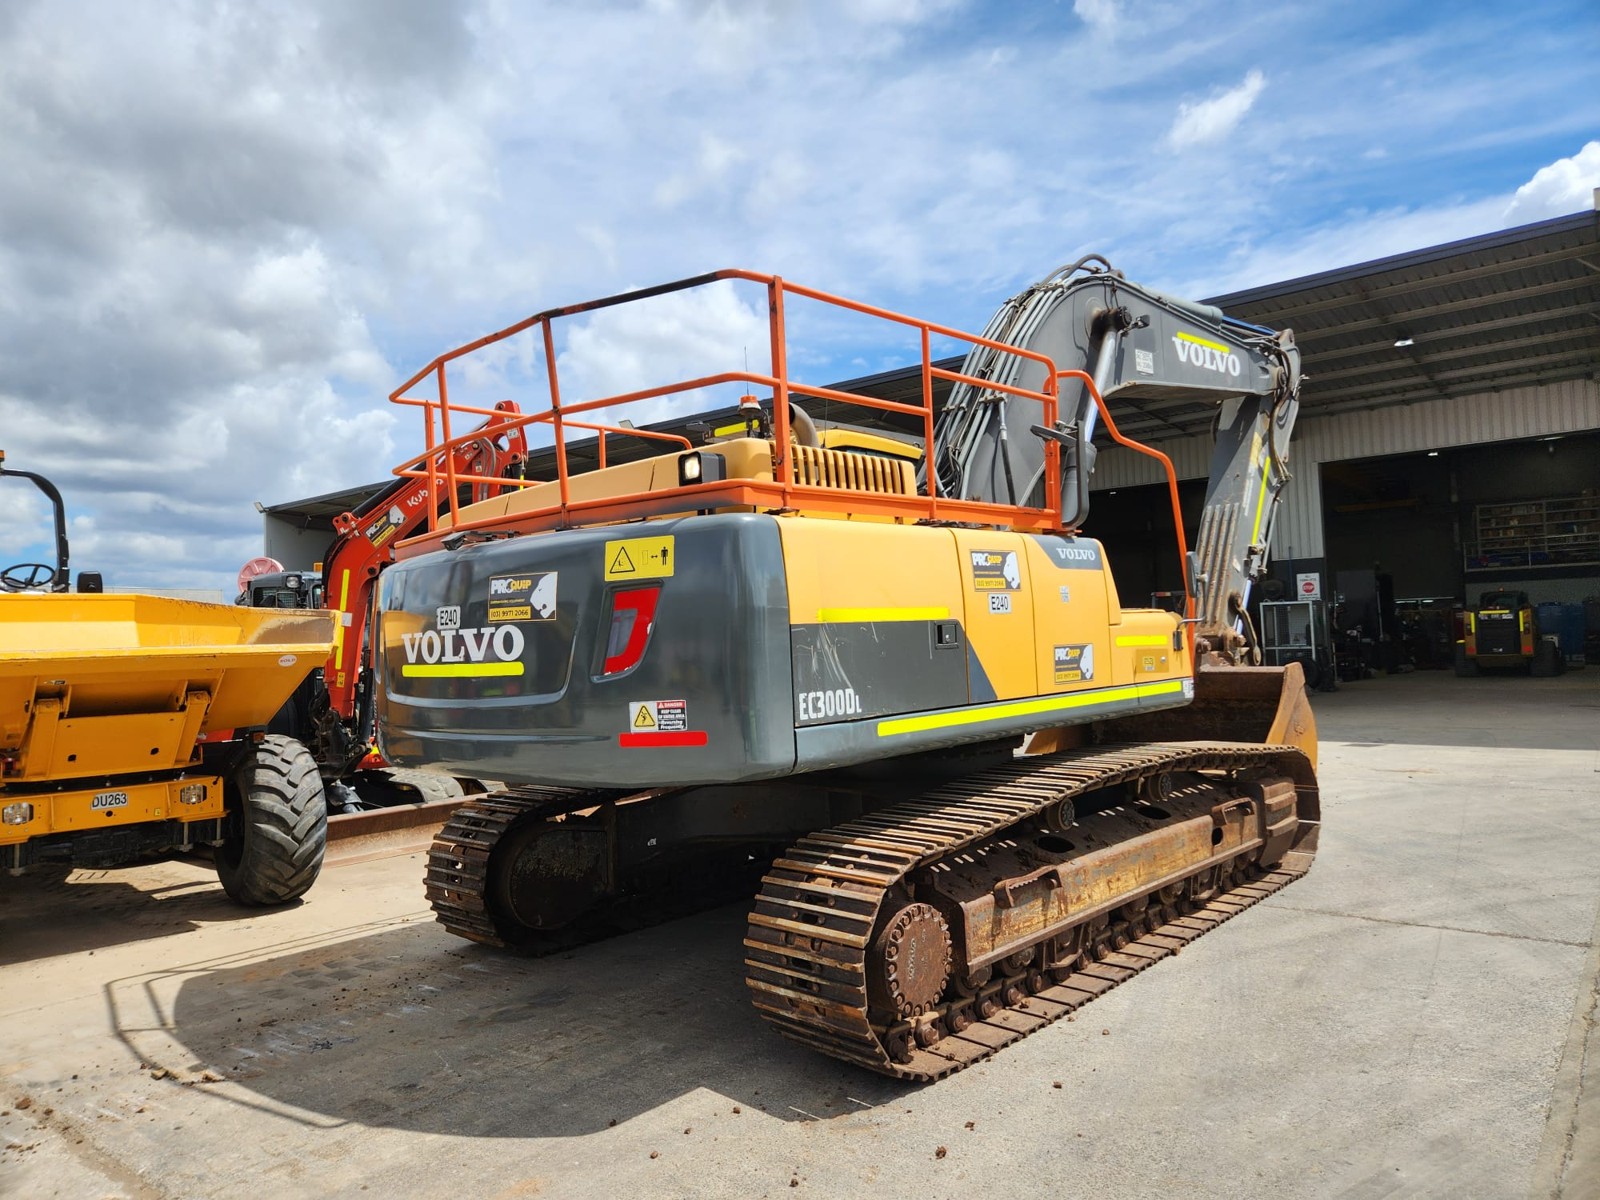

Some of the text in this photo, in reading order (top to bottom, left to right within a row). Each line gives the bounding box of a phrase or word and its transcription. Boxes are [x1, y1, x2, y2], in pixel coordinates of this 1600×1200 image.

[1171, 336, 1241, 377] VOLVO
[407, 478, 444, 507] Kuba
[1056, 547, 1096, 561] VOLVO
[491, 578, 532, 595] PROQUIP
[991, 596, 1009, 611] E240
[439, 609, 458, 627] E240
[401, 624, 525, 664] VOLVO
[798, 688, 862, 721] EC300DL
[92, 793, 127, 808] DU263
